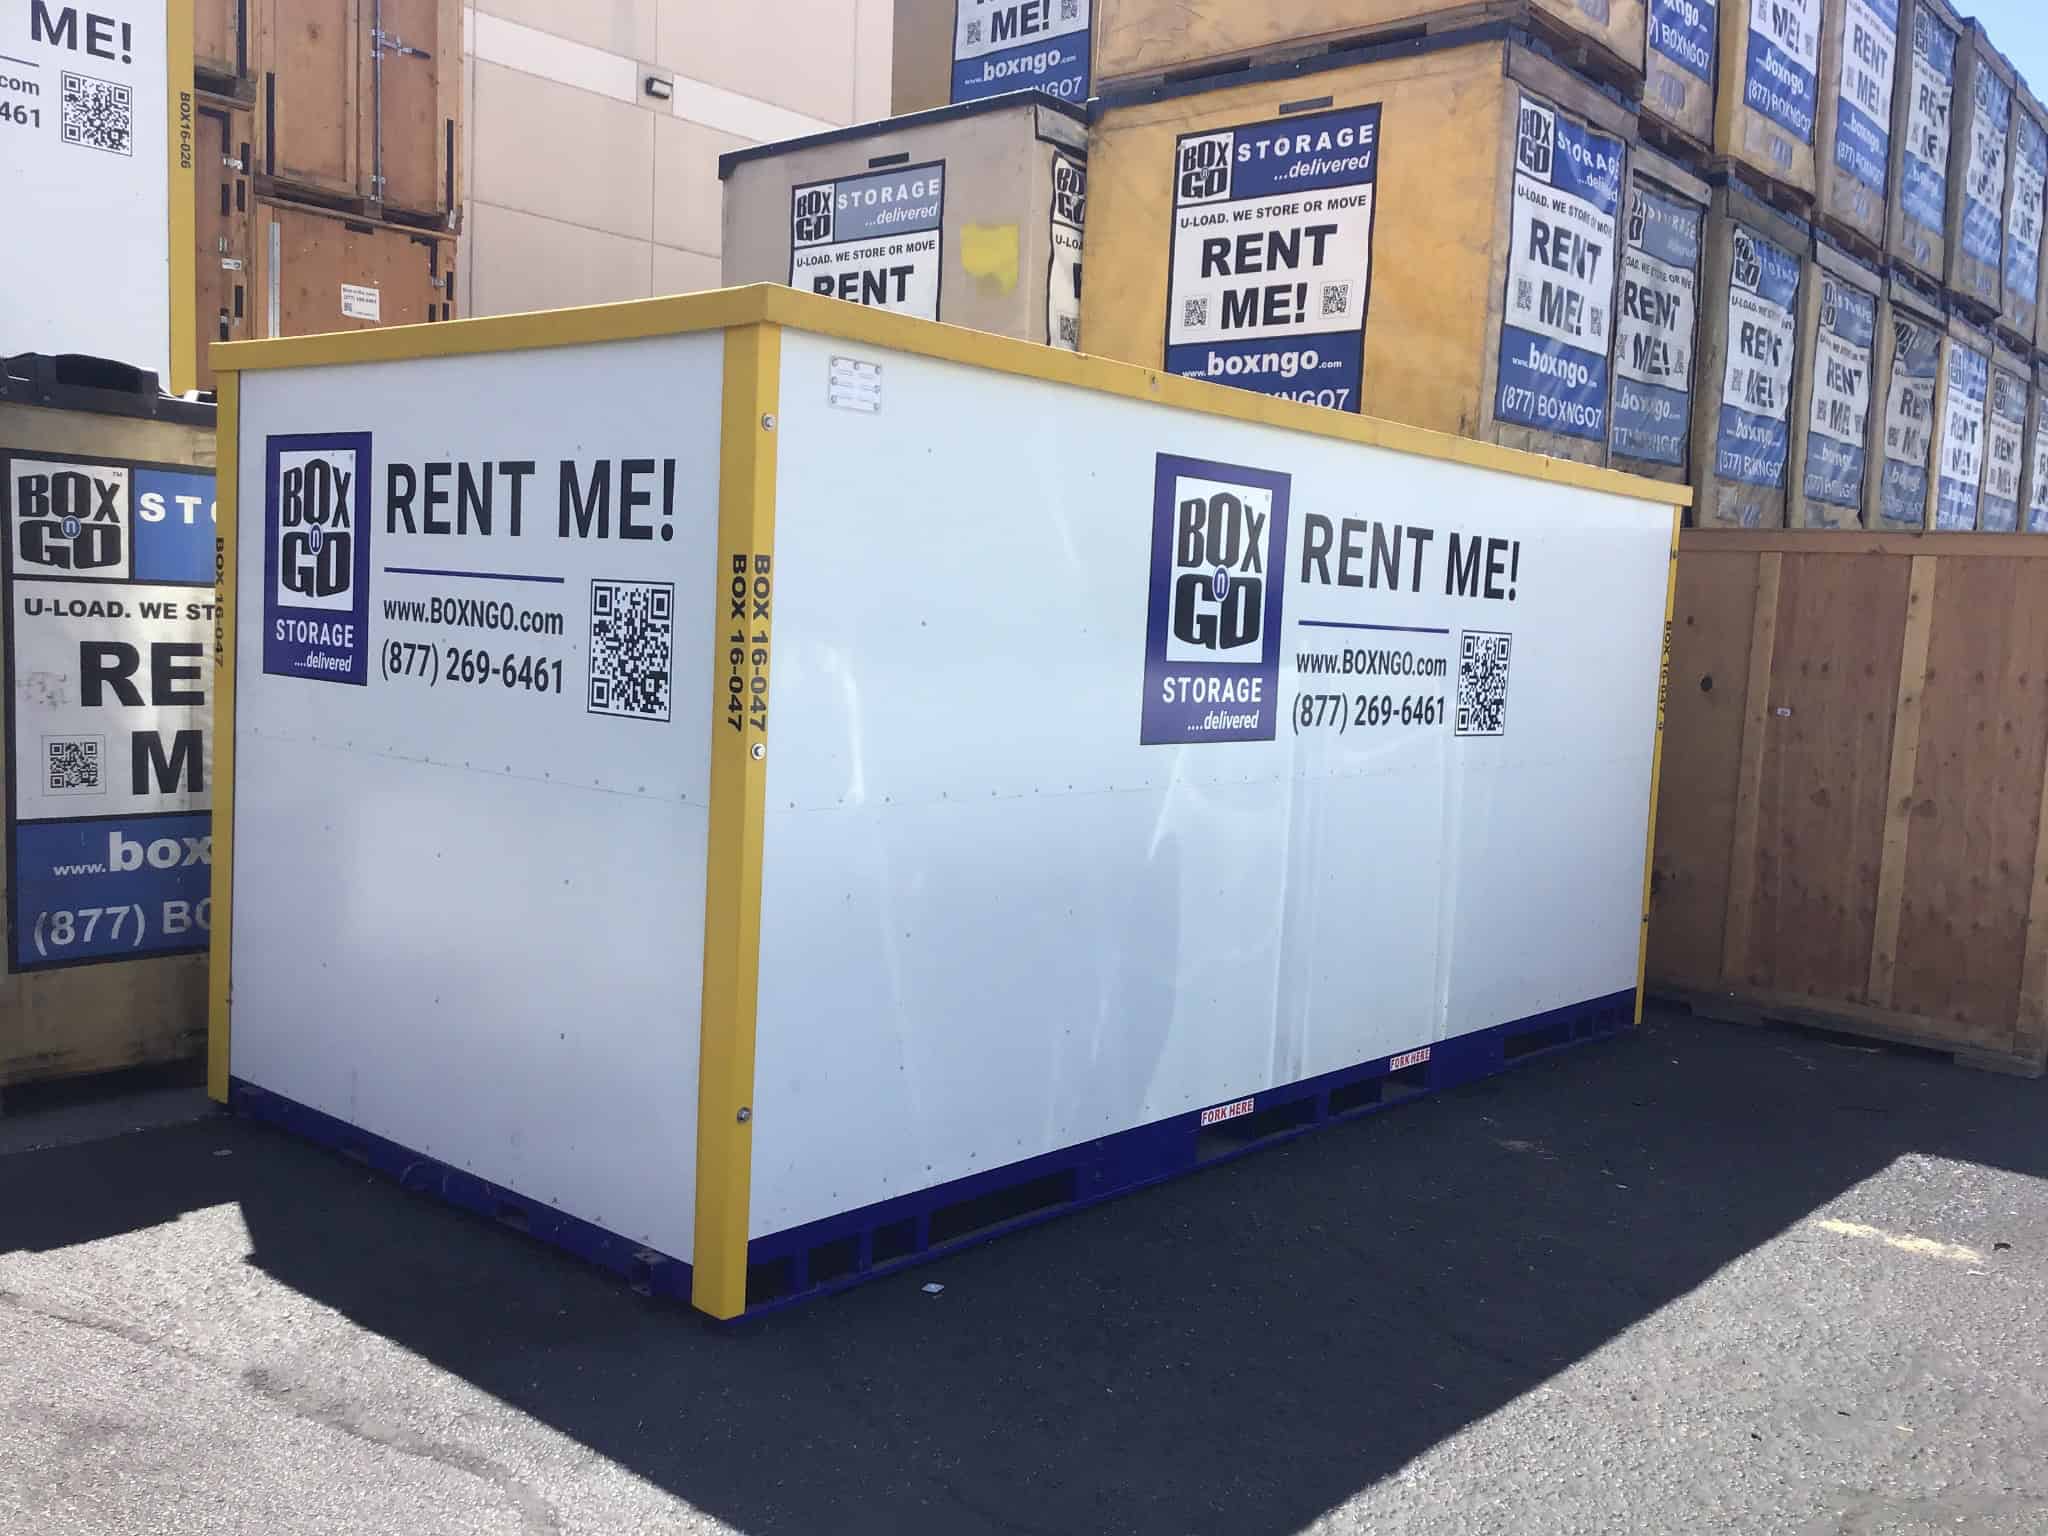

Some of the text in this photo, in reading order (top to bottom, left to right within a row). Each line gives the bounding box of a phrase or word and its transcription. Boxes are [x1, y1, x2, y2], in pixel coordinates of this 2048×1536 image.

[31, 0, 132, 64] ME!
[990, 0, 1050, 43] ME!
[1772, 1, 1801, 55] ME!
[1662, 23, 1710, 71] BOXNGO7
[1854, 24, 1888, 79] RENT
[1748, 77, 1770, 112] (877)
[1857, 68, 1880, 116] ME!
[1237, 124, 1374, 163] STORAGE
[1521, 108, 1551, 146] BOX
[1182, 140, 1230, 172] BOX
[1274, 151, 1371, 181] ...delivered
[1519, 137, 1551, 173] GO
[796, 190, 832, 218] BOX
[837, 178, 940, 210] STORAGE
[1180, 168, 1227, 198] GO
[1518, 184, 1549, 209] U-LOAD.
[1552, 200, 1567, 213] WE
[865, 203, 938, 227] ...delivered
[1180, 194, 1367, 229] U-LOAD. WE STORE OR MOVE
[796, 239, 936, 268] U-LOAD. WE STORE OR MOVE
[1201, 224, 1338, 278] RENT
[1529, 217, 1602, 285] RENT
[813, 264, 914, 306] RENT
[1221, 282, 1308, 330] ME!
[1623, 279, 1681, 331] RENT
[1539, 280, 1584, 337] ME!
[1181, 350, 1343, 378] www.boxngo.com
[1633, 332, 1670, 377] ME!
[1501, 384, 1536, 420] (877)
[1537, 395, 1602, 429] BOXNGO7
[18, 471, 121, 523] BOX
[139, 492, 216, 524] ST
[282, 458, 352, 528] BOX
[386, 458, 677, 542] RENT ME!
[19, 520, 122, 570] GO
[1177, 492, 1266, 574] BOX
[215, 537, 225, 583] BOX
[281, 531, 352, 599] GO
[1301, 512, 1521, 602] RENT ME!
[24, 598, 130, 619] U-LOAD.
[140, 602, 178, 620] WE
[383, 597, 564, 636] www.BOXNGO.com
[1173, 573, 1263, 651] GO
[276, 618, 355, 649] STORAGE
[727, 554, 748, 733] BOX 16-047
[749, 553, 771, 732] BOX 16-047
[79, 641, 205, 706] RE
[381, 638, 563, 694] (877) 269-6461
[1296, 649, 1448, 678] www.BOXNGO.com
[1162, 676, 1264, 704] STORAGE
[1292, 692, 1446, 736] (877) 269-6461
[131, 729, 204, 796] M
[33, 903, 146, 956] (877)
[1391, 1048, 1431, 1070] FORK HERE
[1201, 1098, 1254, 1125] FORK HERE
